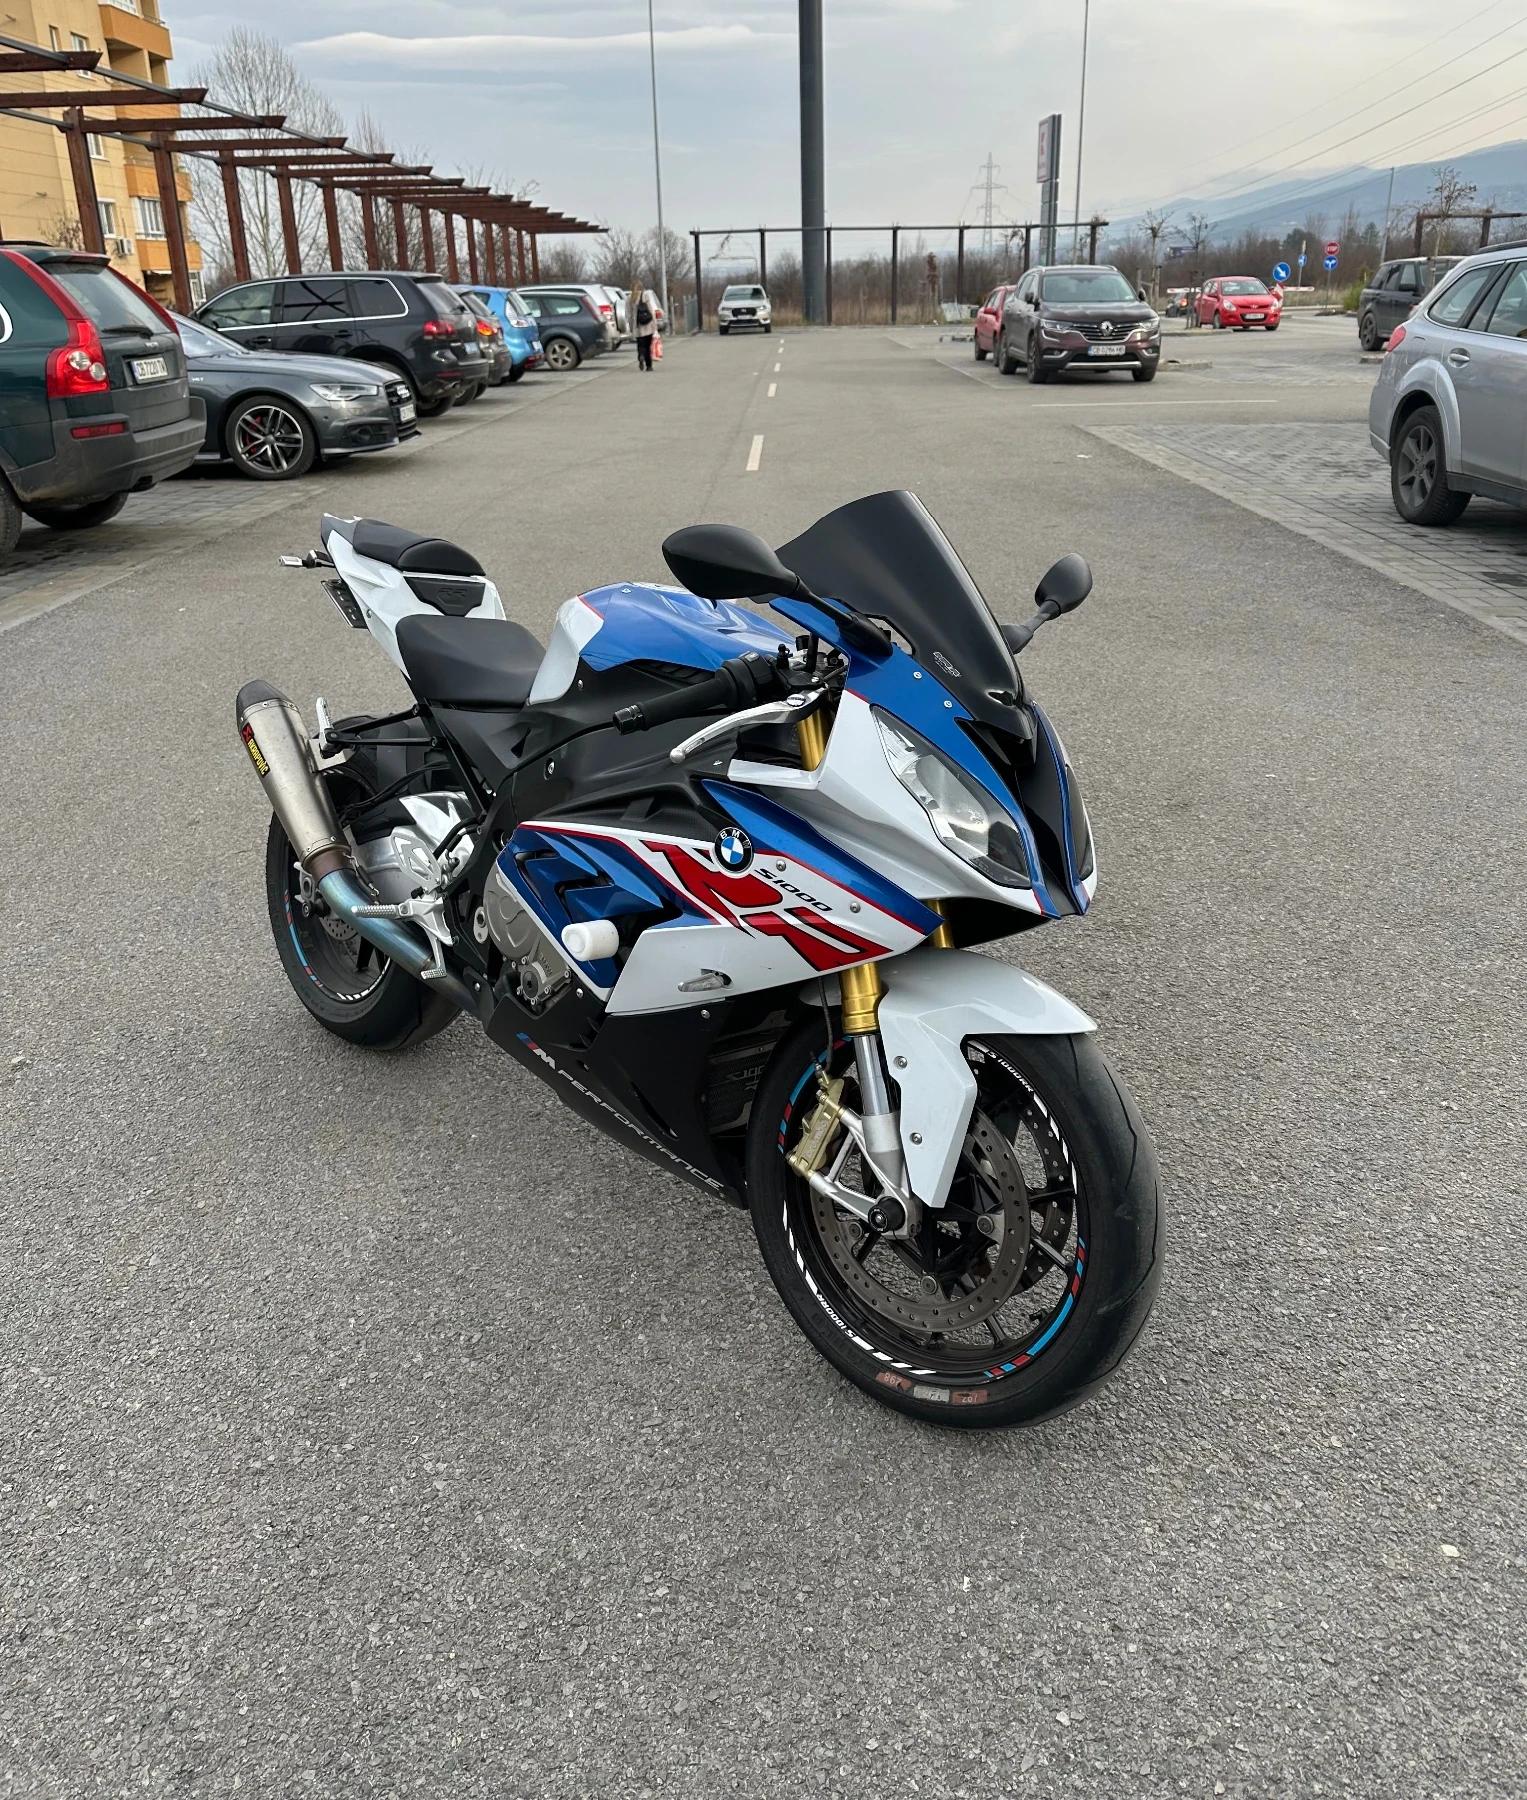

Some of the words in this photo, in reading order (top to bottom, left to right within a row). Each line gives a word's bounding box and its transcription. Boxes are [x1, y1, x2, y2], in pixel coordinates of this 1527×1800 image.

[720, 829, 751, 849] BMW
[754, 868, 833, 912] S1000
[558, 1069, 725, 1191] PERFORMANCE
